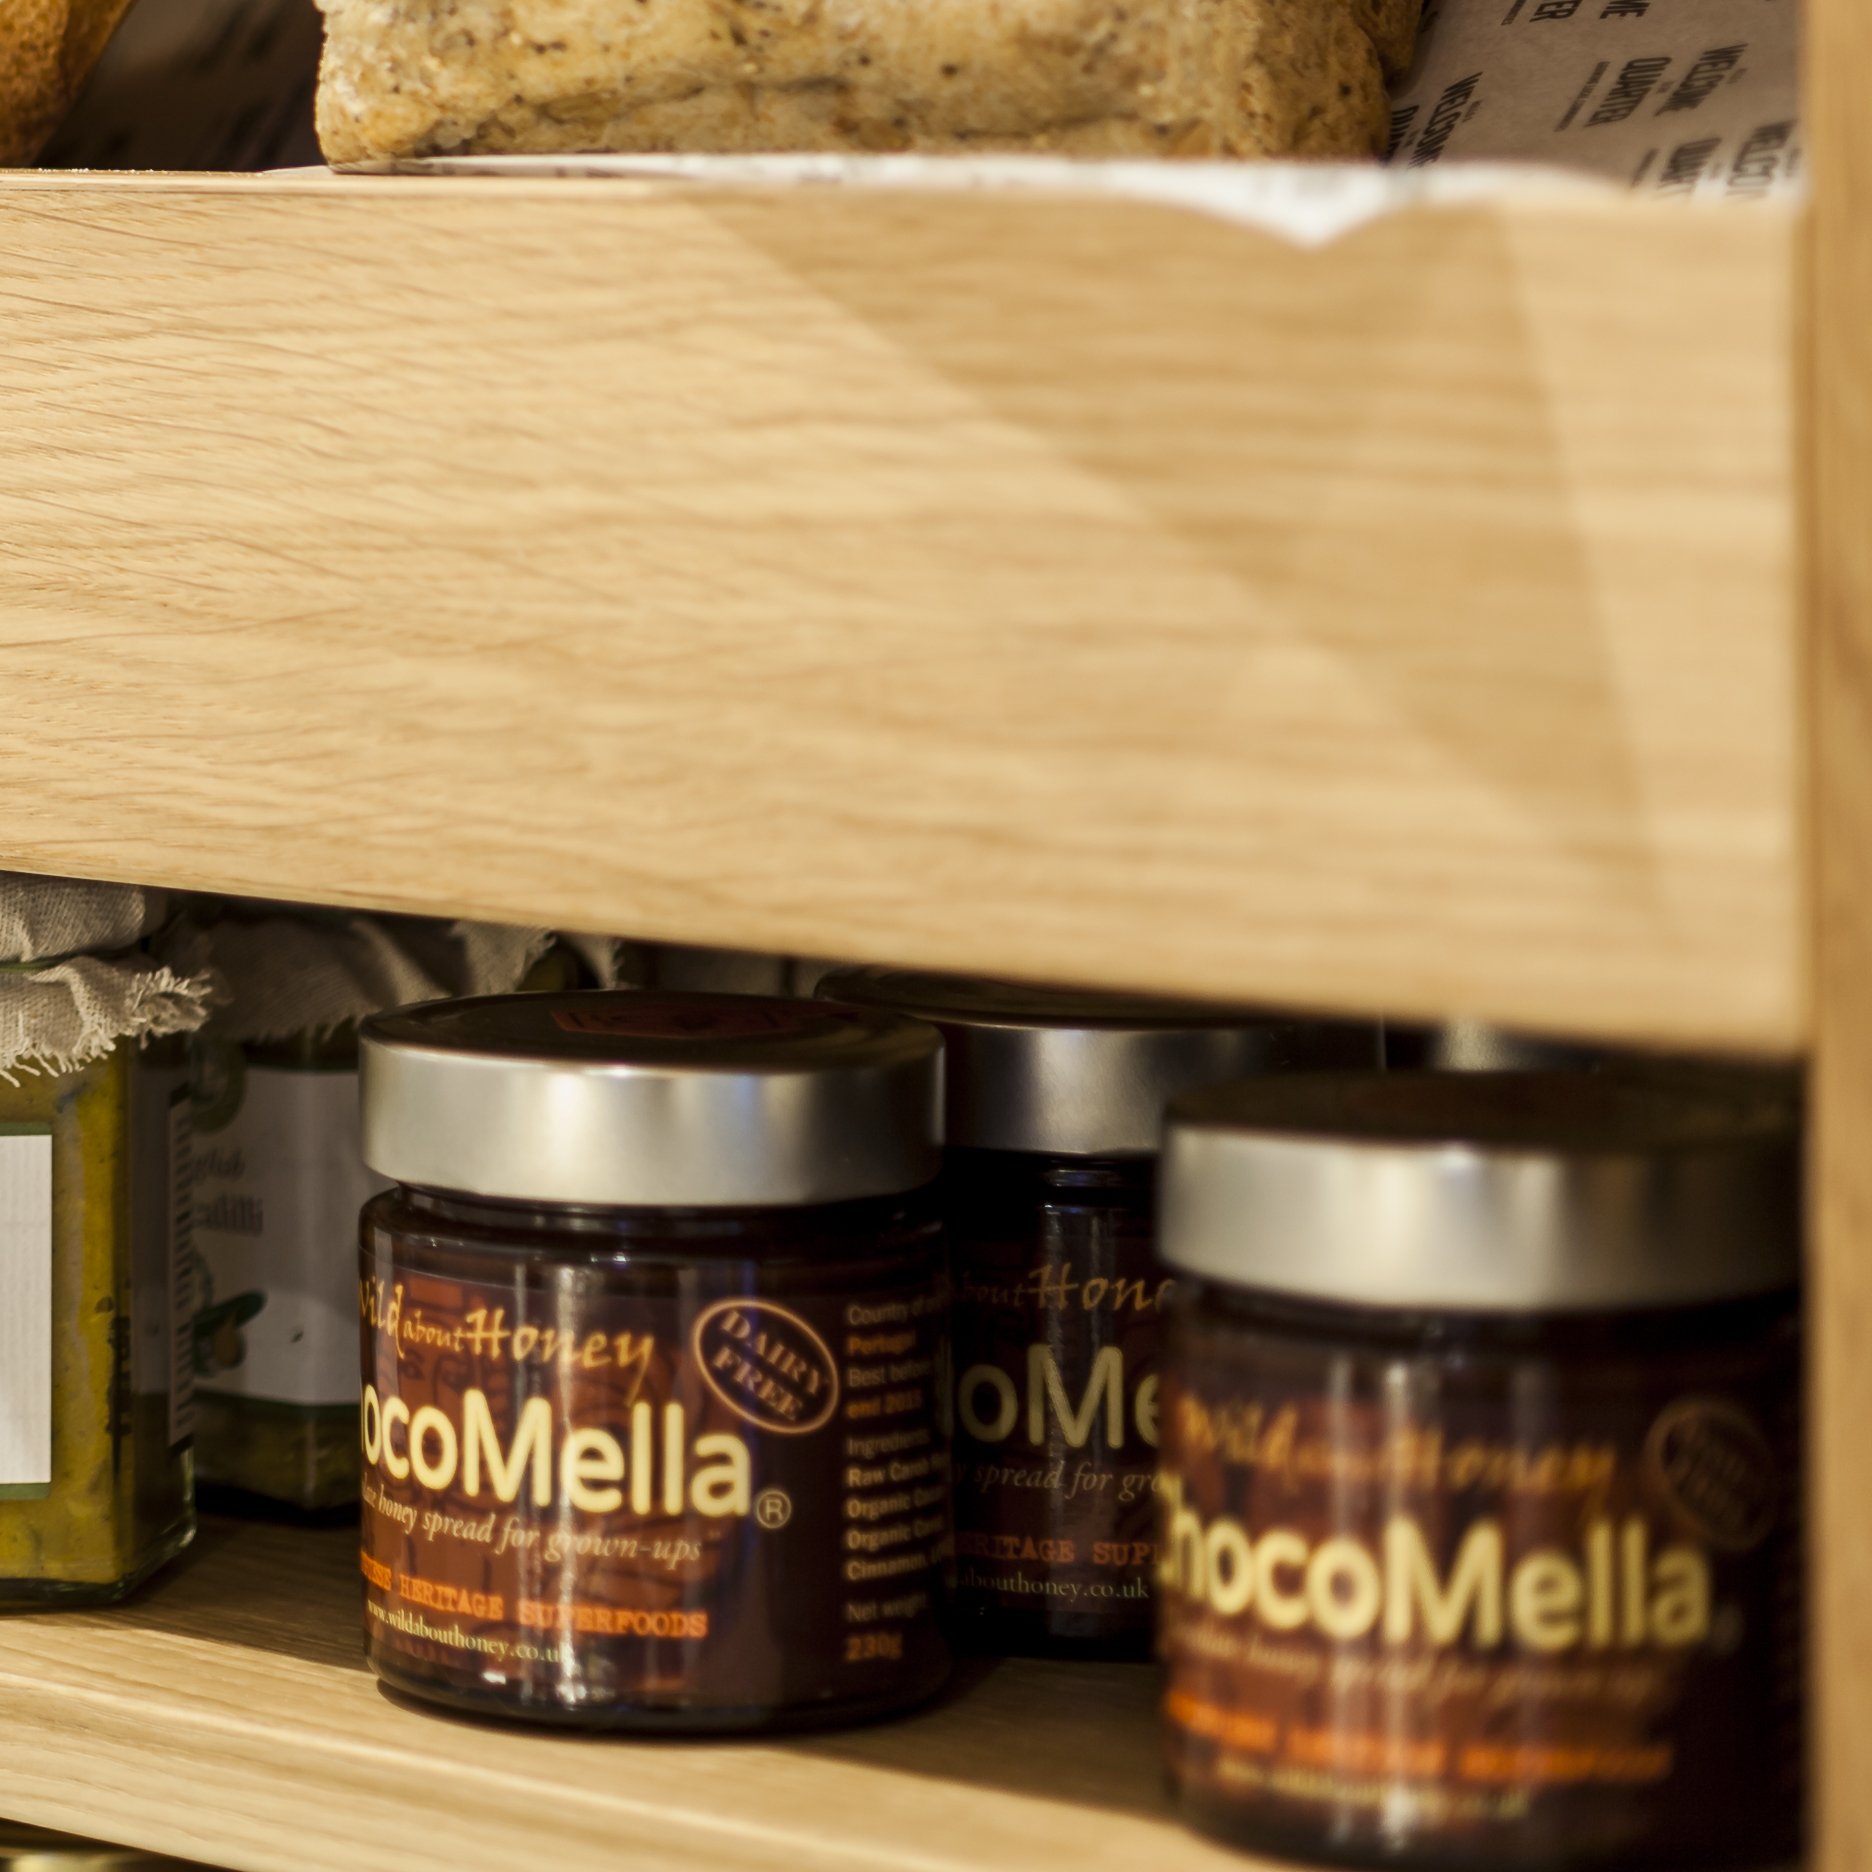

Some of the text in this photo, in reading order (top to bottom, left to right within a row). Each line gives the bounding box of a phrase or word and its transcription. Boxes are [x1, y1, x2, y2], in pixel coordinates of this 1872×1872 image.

[403, 1309, 464, 1353] about
[461, 1306, 654, 1409] Honey
[712, 1345, 803, 1422] FREE
[721, 1309, 819, 1395] DAIRY
[848, 1365, 887, 1388] Best
[975, 1460, 1065, 1494] spread
[1064, 1460, 1115, 1500] for
[378, 1482, 418, 1536] honey
[422, 1511, 497, 1543] spread
[493, 1515, 541, 1556] for
[399, 1574, 505, 1621] HERITAGE
[517, 1598, 709, 1639] SUPERFOODS
[847, 1601, 878, 1622] Net
